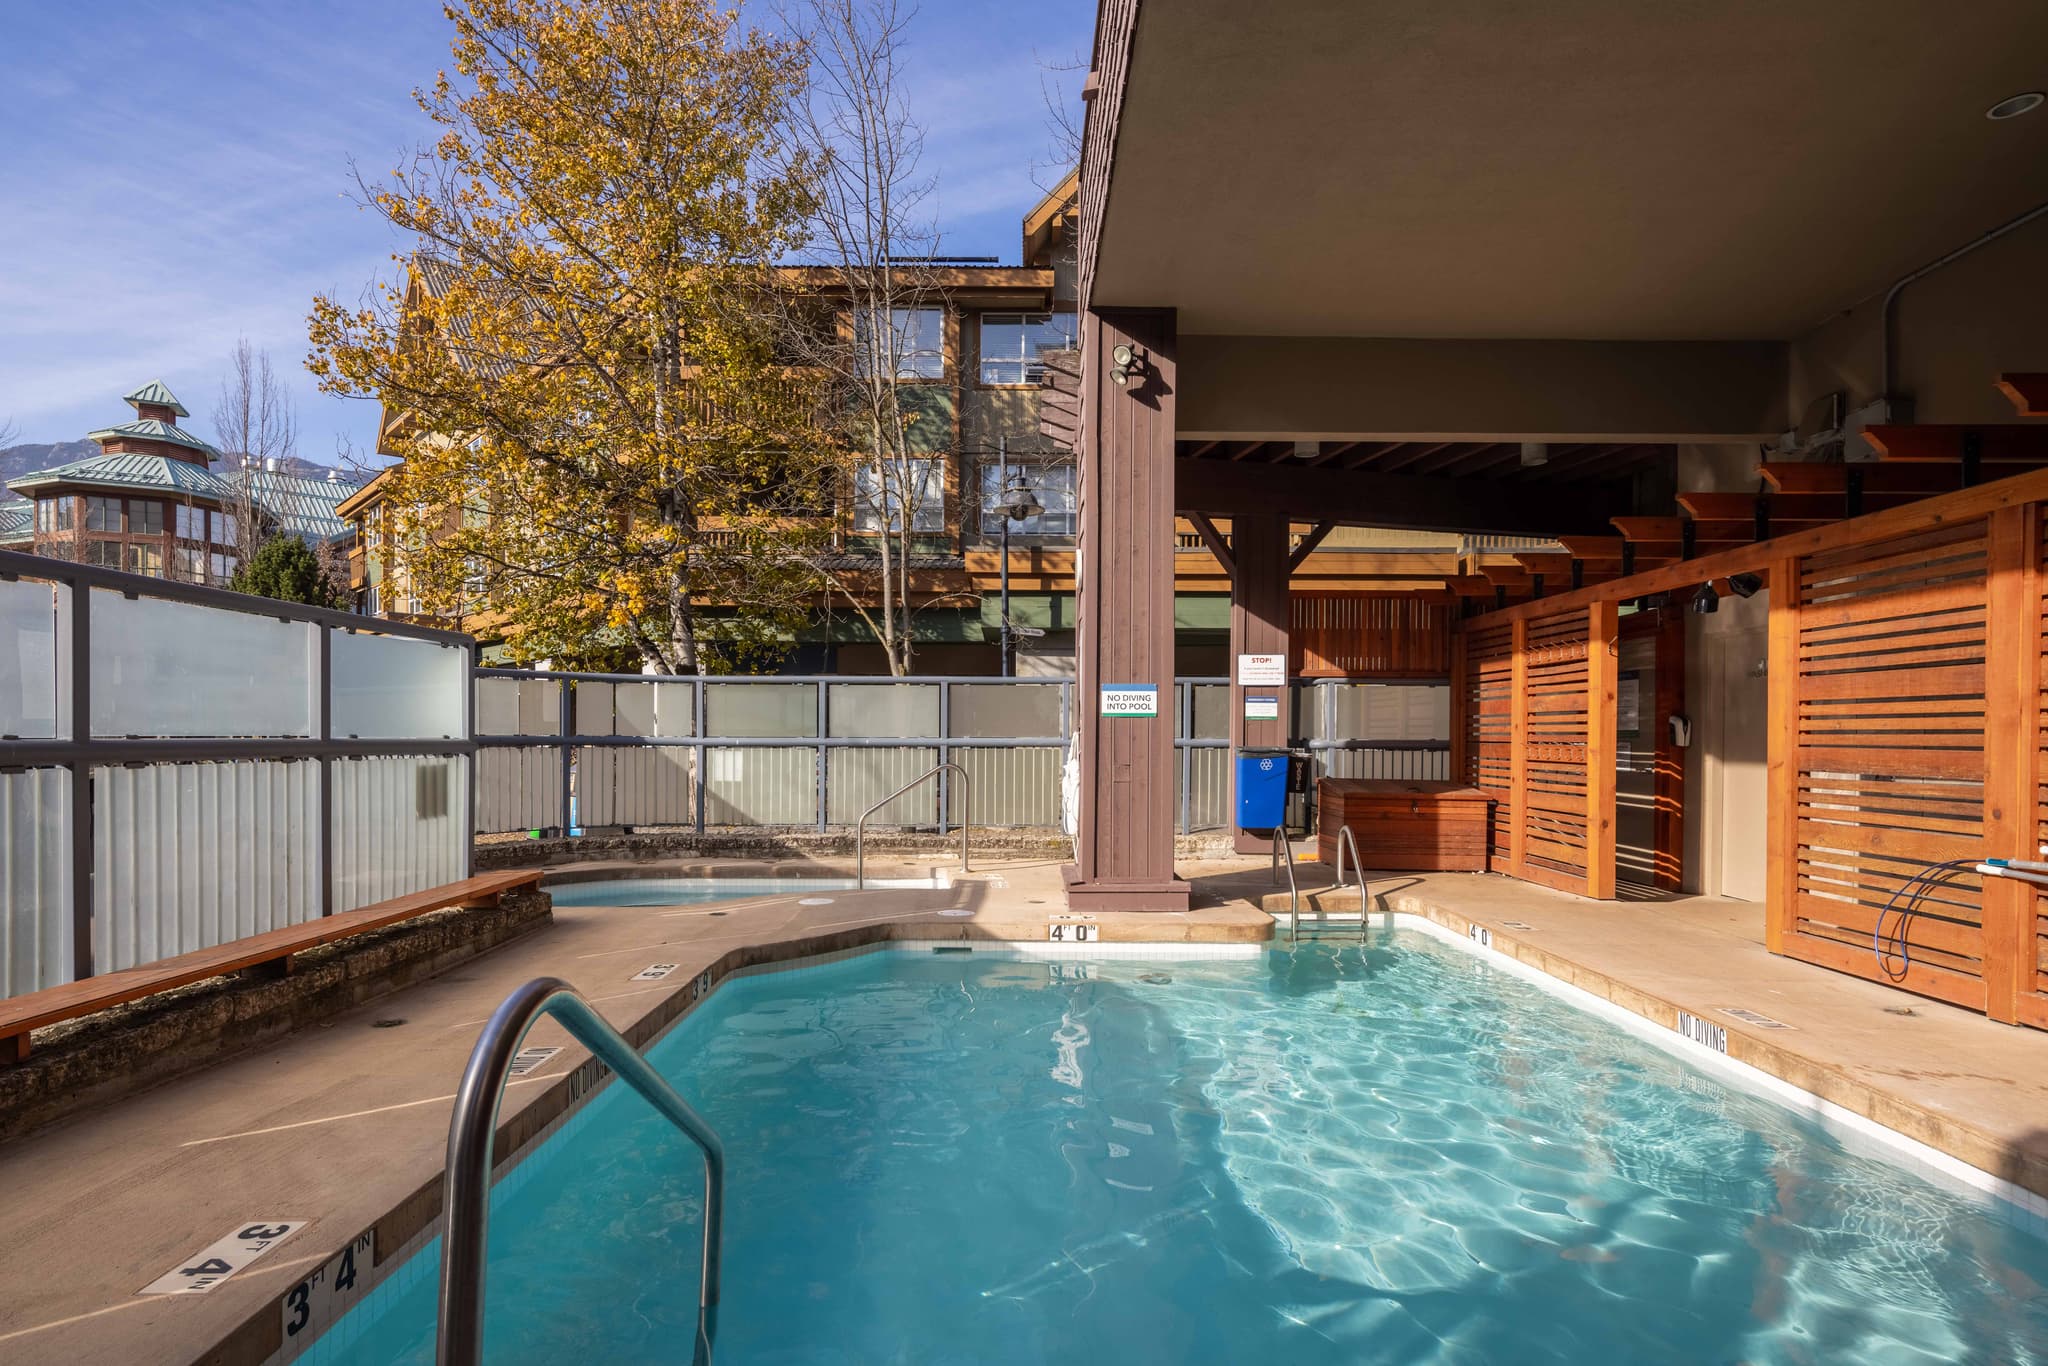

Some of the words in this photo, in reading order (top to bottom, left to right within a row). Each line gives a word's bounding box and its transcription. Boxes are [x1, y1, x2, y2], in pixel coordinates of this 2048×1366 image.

[1106, 702, 1128, 711] INTO
[1128, 702, 1152, 711] POOL
[1107, 694, 1121, 702] NO
[1122, 694, 1152, 702] DIVING
[1051, 925, 1064, 941] 4
[1075, 925, 1088, 941] 0
[1470, 924, 1476, 941] 4
[1481, 929, 1488, 946] 0
[692, 979, 699, 1001] 3
[703, 970, 708, 993] 9
[1680, 1011, 1691, 1038] NO
[1695, 1017, 1725, 1054] DIVING
[570, 1071, 580, 1104] NO
[238, 1224, 291, 1240] 3
[179, 1257, 233, 1277] 4
[287, 1282, 310, 1337] 3
[311, 1266, 326, 1290] FT
[335, 1246, 357, 1293] 4
[357, 1231, 371, 1253] IN
